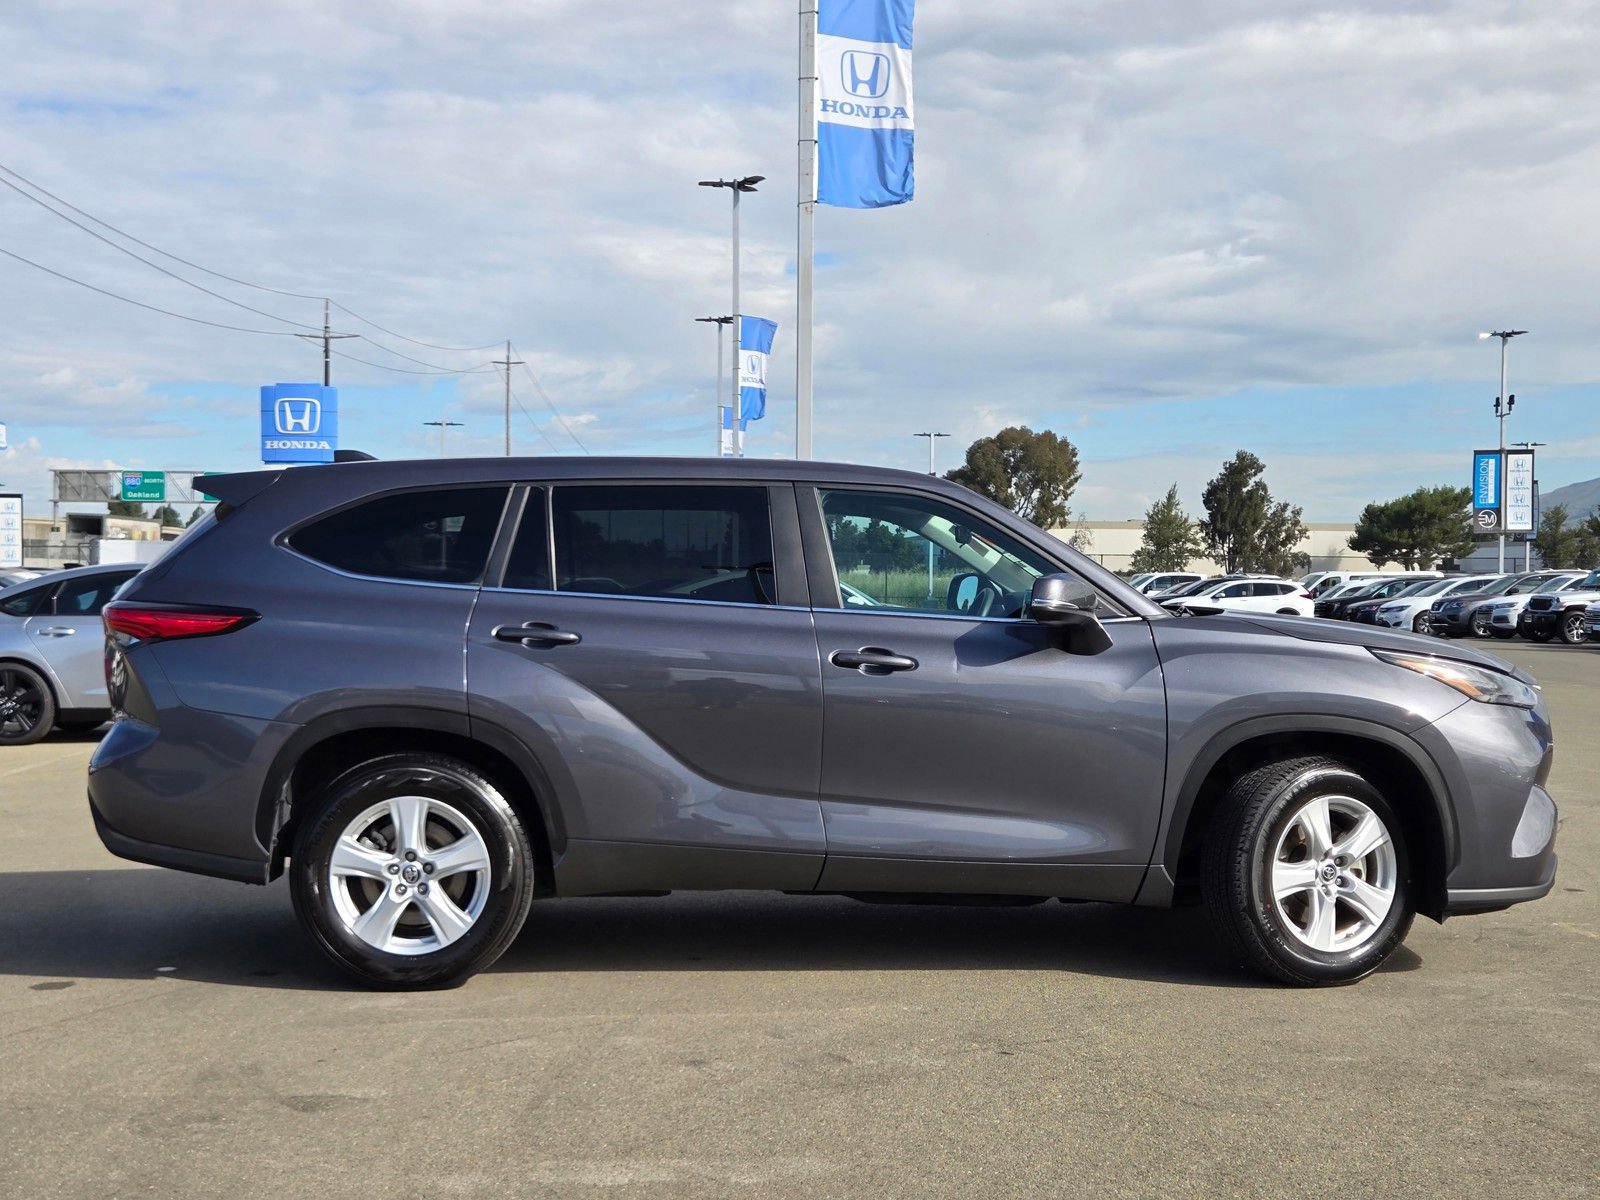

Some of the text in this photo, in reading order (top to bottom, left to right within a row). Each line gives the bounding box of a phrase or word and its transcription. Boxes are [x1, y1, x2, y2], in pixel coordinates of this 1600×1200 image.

[820, 98, 910, 120] HONDA
[264, 440, 332, 450] HONDA
[1479, 458, 1489, 504] ENVISION
